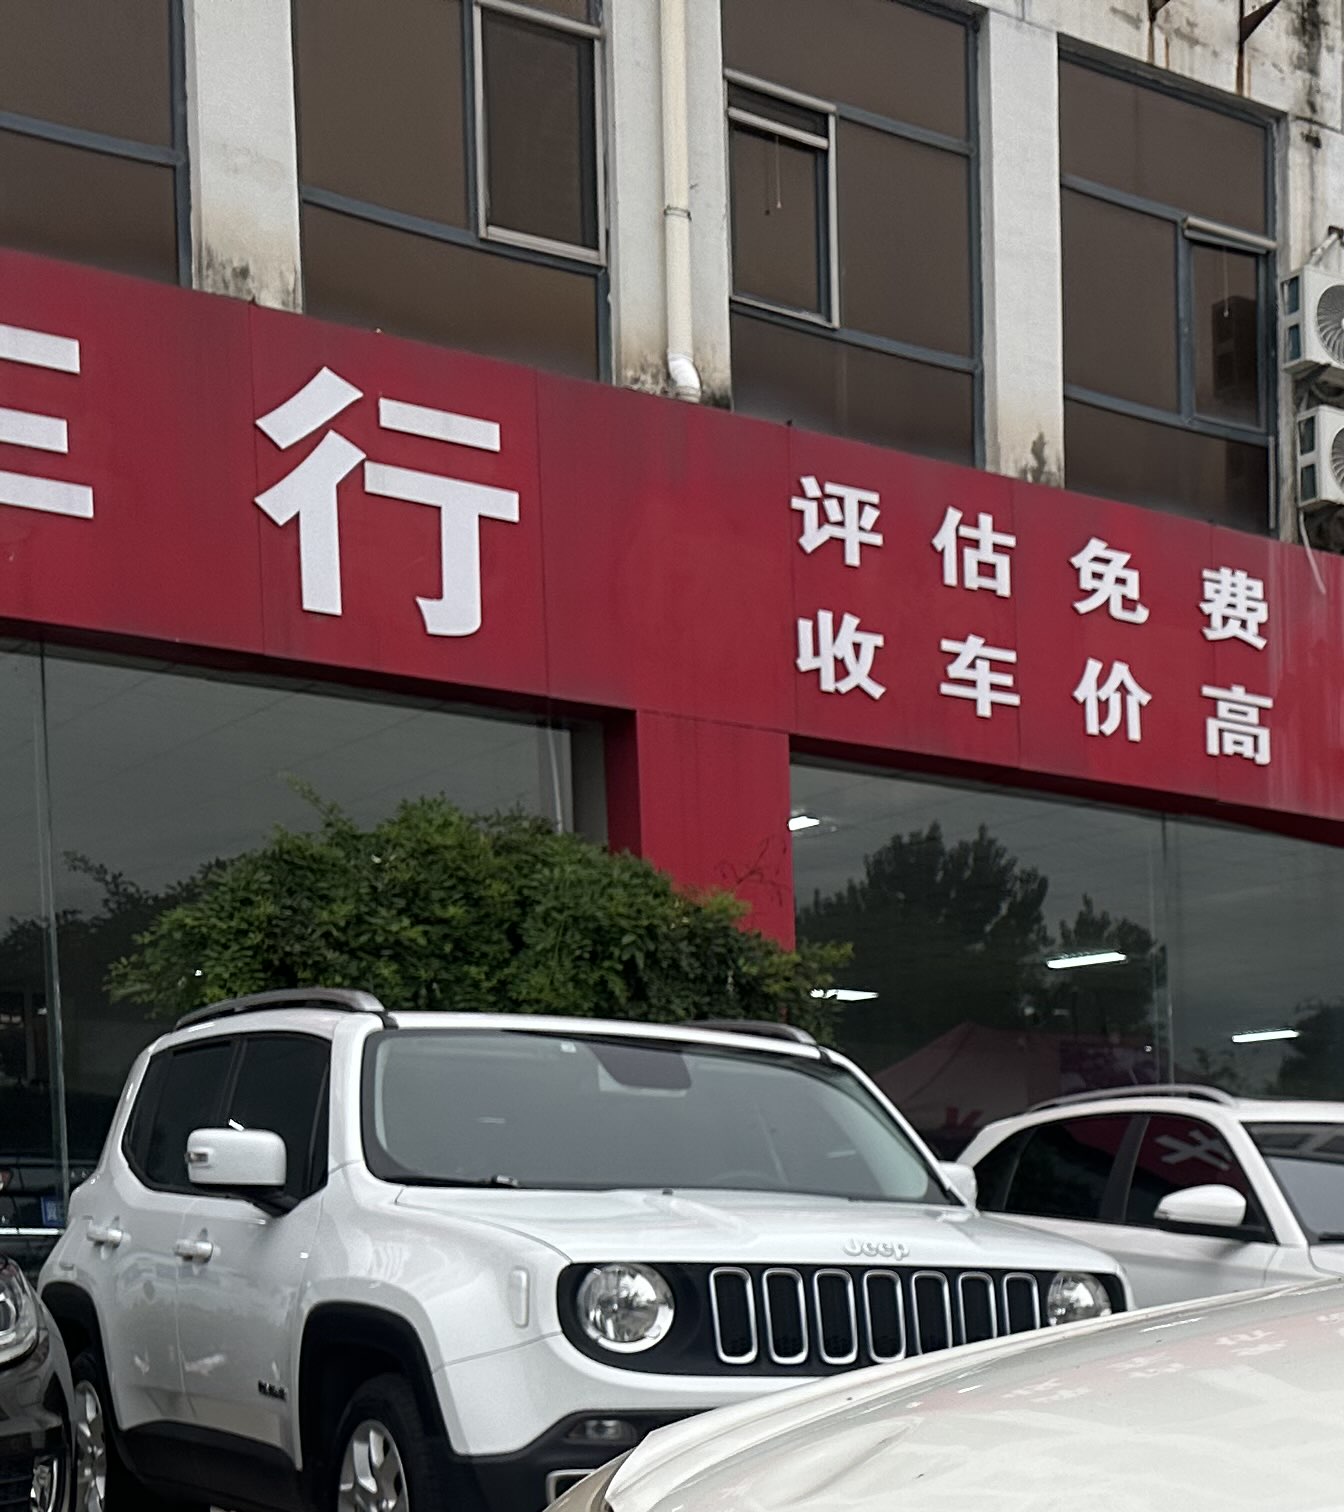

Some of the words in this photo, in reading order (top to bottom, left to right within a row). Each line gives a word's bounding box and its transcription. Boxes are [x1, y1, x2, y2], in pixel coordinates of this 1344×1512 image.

[791, 475, 1268, 651] 评估免费
[795, 609, 1274, 766] 收车价高
[843, 1238, 910, 1261] Jeep
